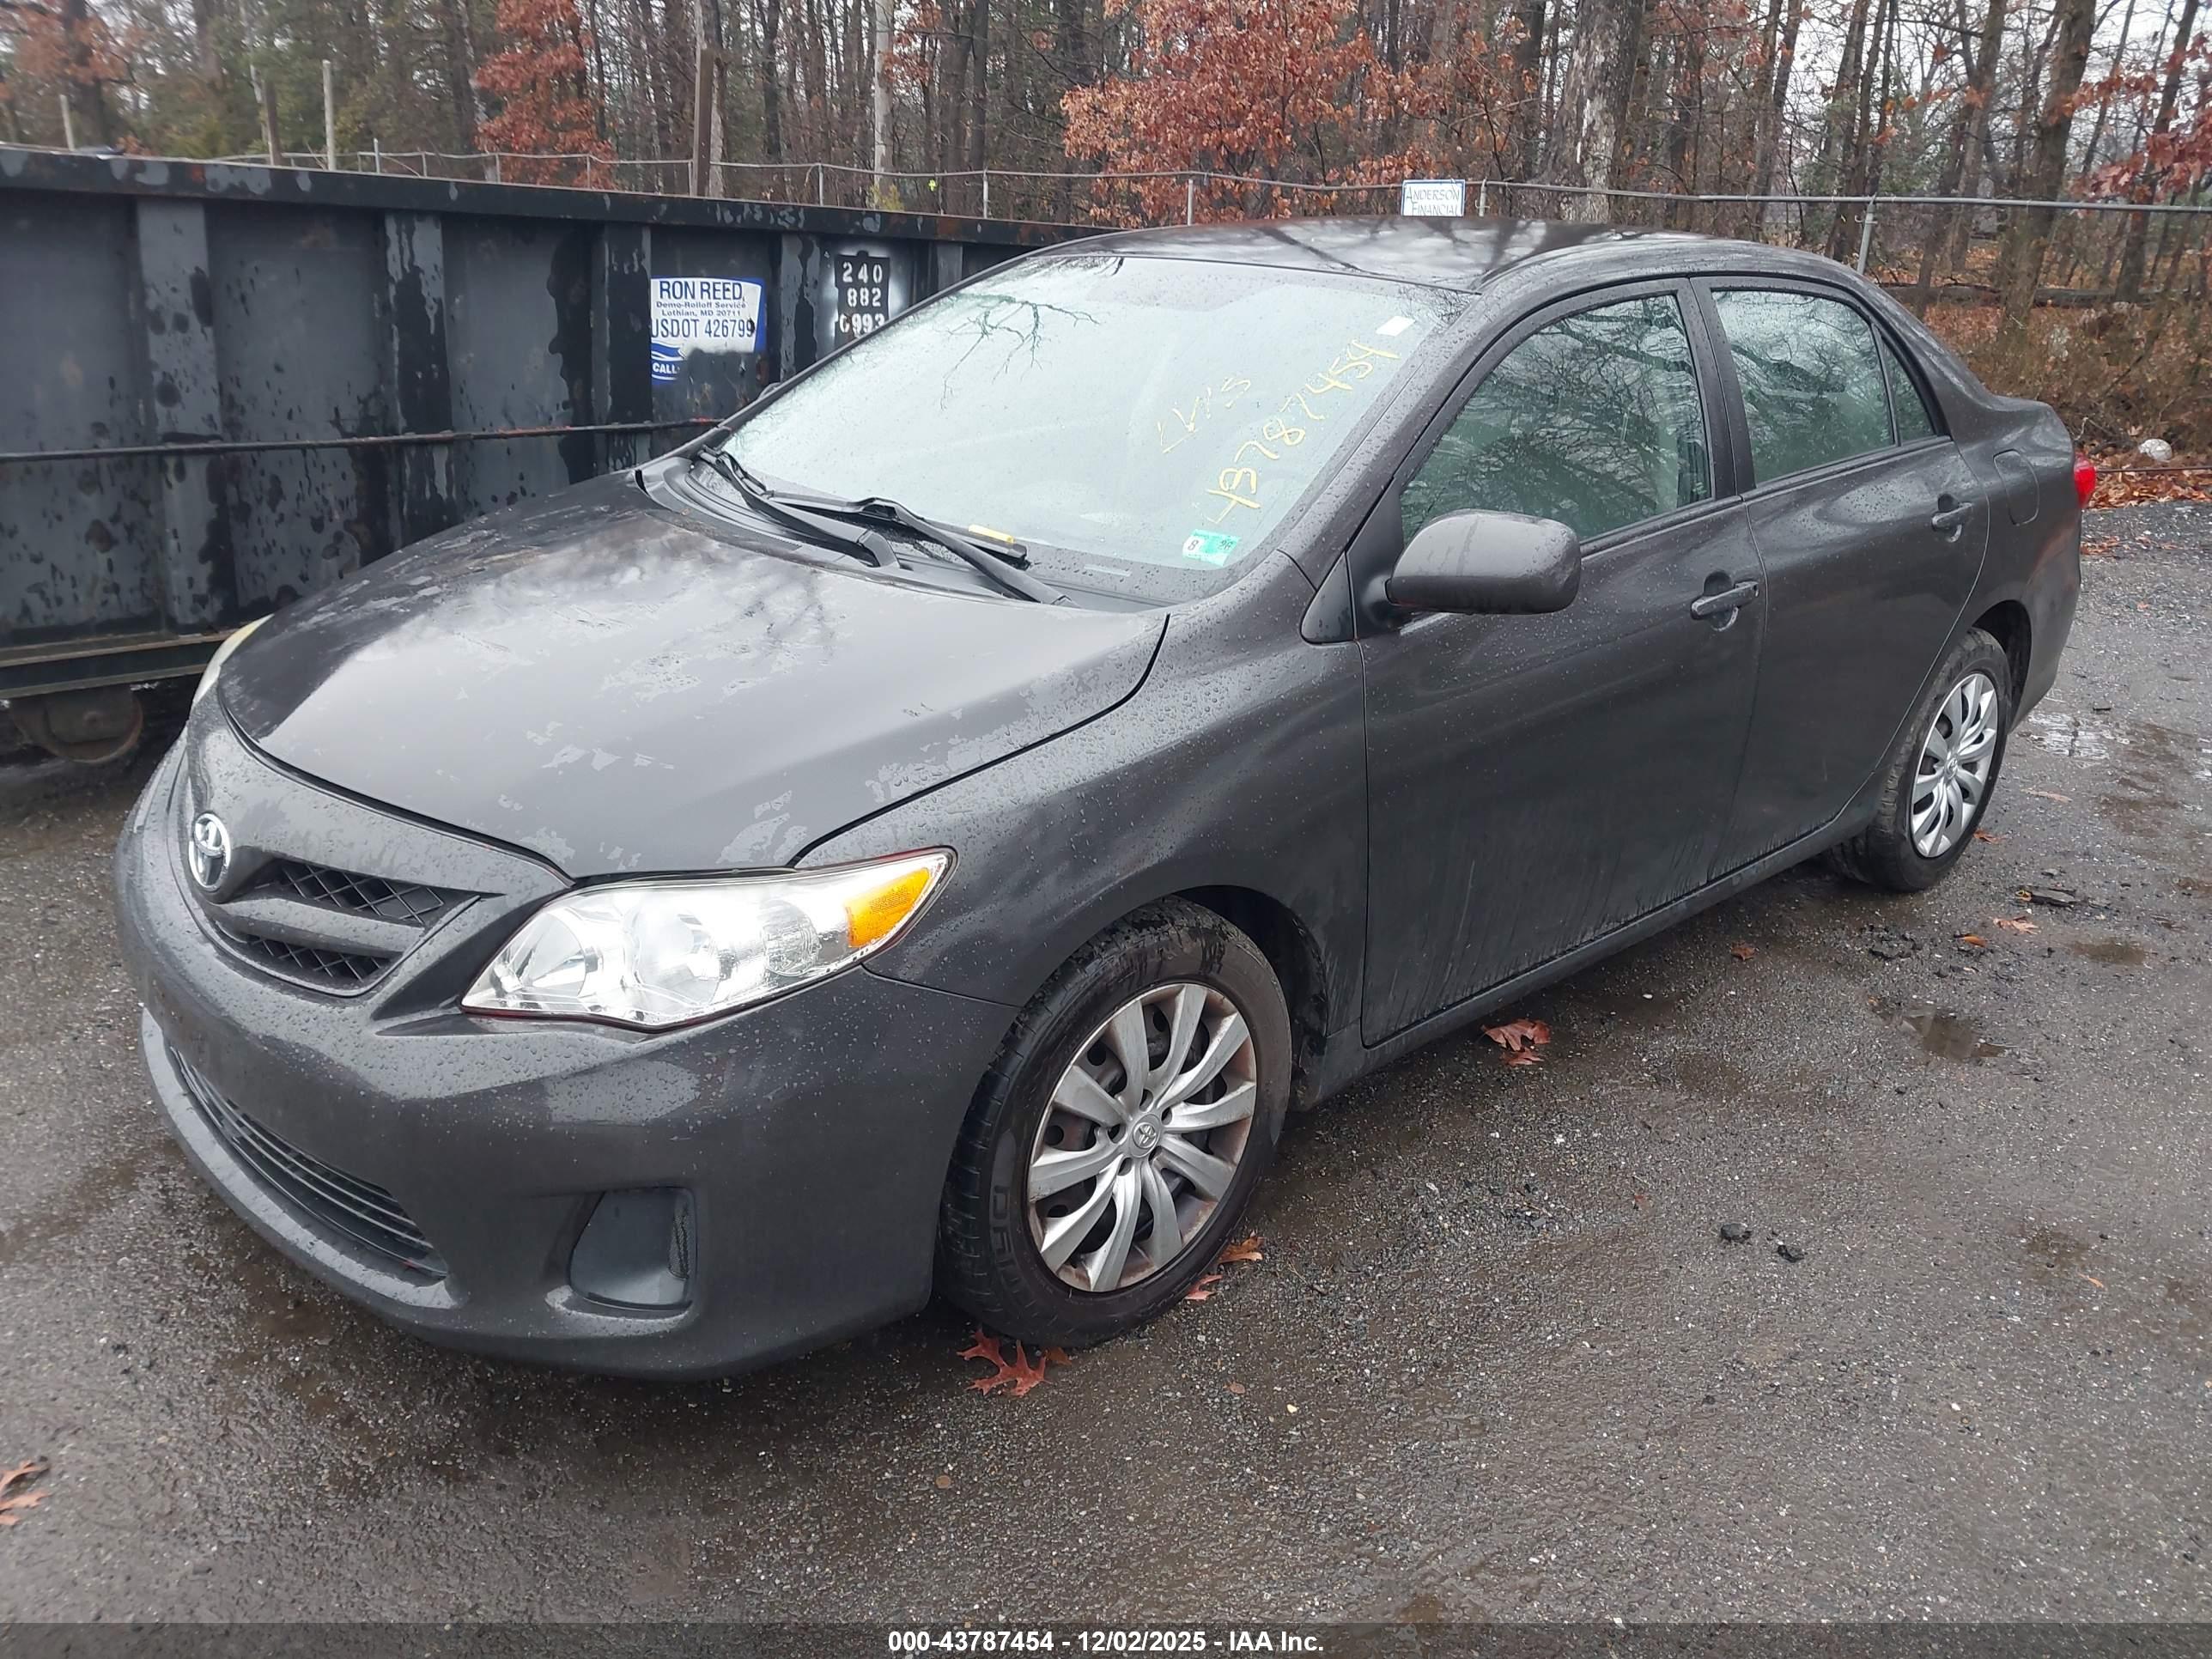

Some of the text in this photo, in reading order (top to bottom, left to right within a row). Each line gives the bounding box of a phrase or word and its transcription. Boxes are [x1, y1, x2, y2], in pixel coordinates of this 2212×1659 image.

[1407, 185, 1460, 202] ANDERSON
[842, 261, 883, 283] 240
[659, 280, 743, 301] RON REED
[847, 287, 881, 307] 882
[661, 308, 698, 317] Lothian,
[652, 318, 755, 338] USDOT 426799
[1187, 538, 1200, 551] 8
